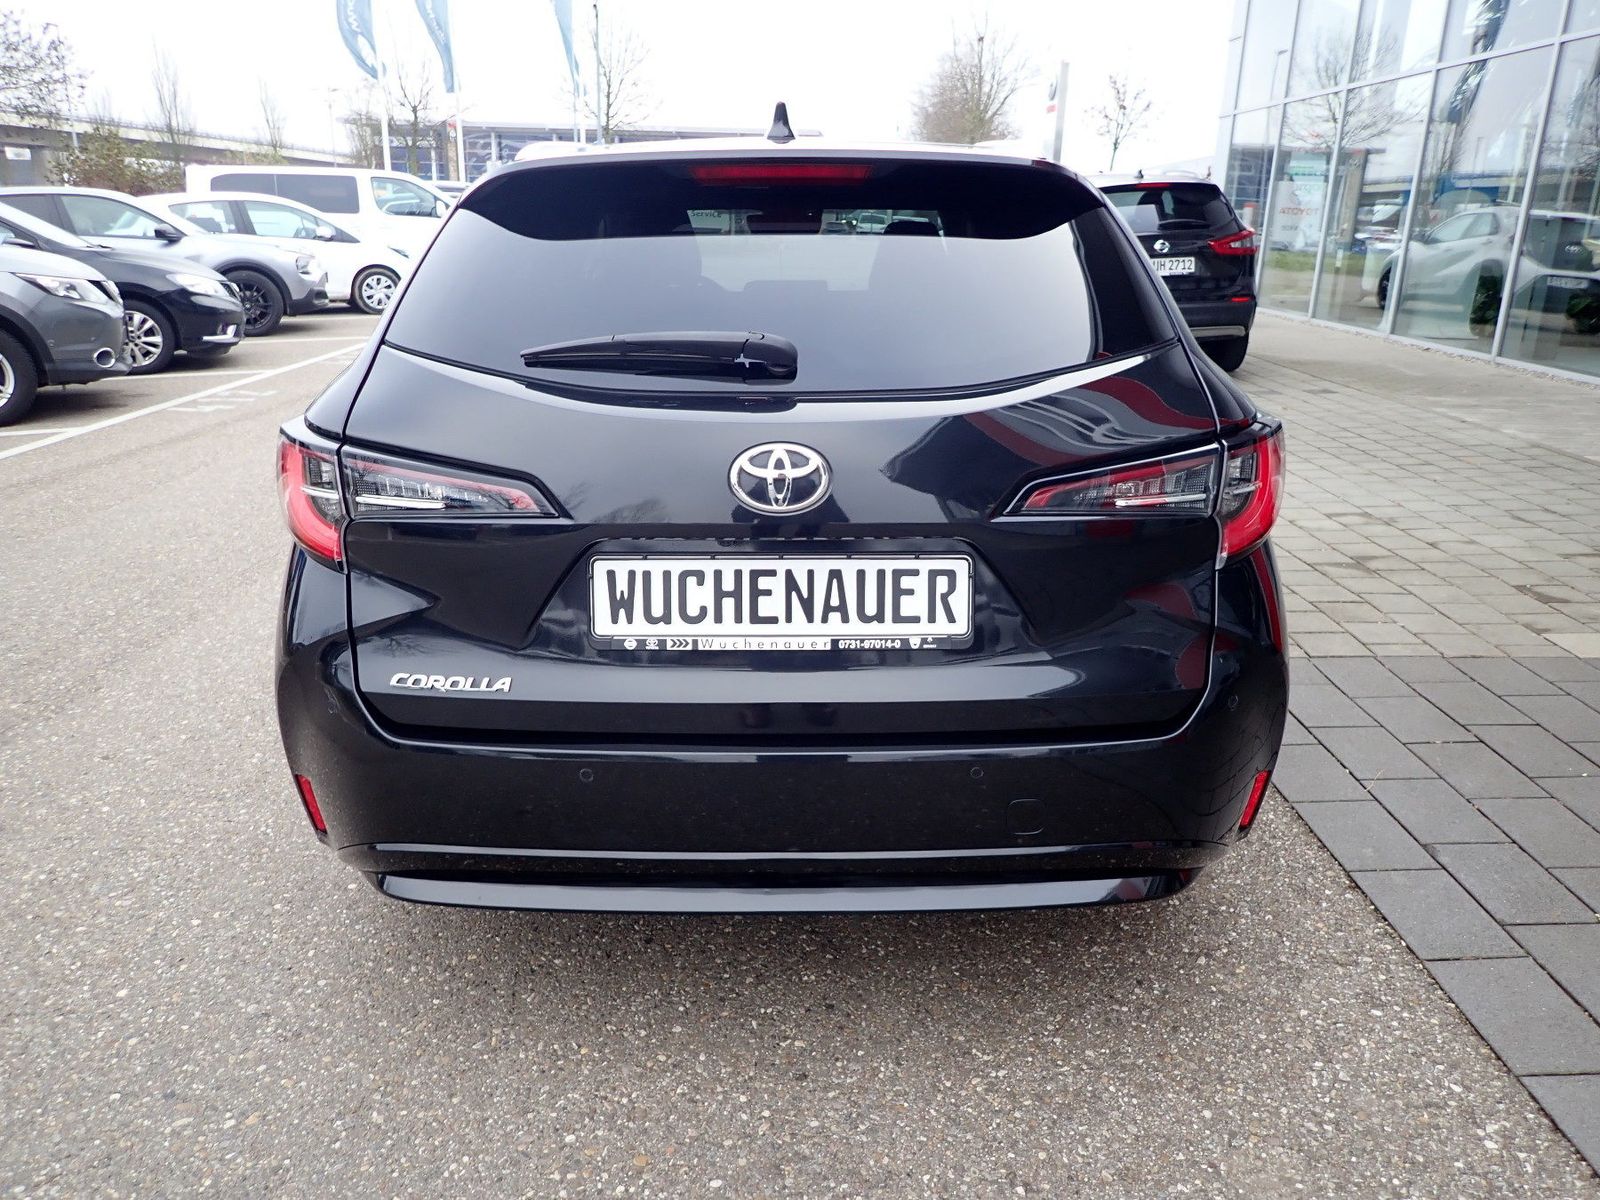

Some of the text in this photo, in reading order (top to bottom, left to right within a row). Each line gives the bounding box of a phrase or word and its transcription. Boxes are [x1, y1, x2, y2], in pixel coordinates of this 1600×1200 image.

[1168, 259, 1193, 271] 2712
[606, 568, 957, 625] WUCHENAUER
[701, 639, 831, 650] Wuchenauer
[390, 672, 512, 693] COROLLA
